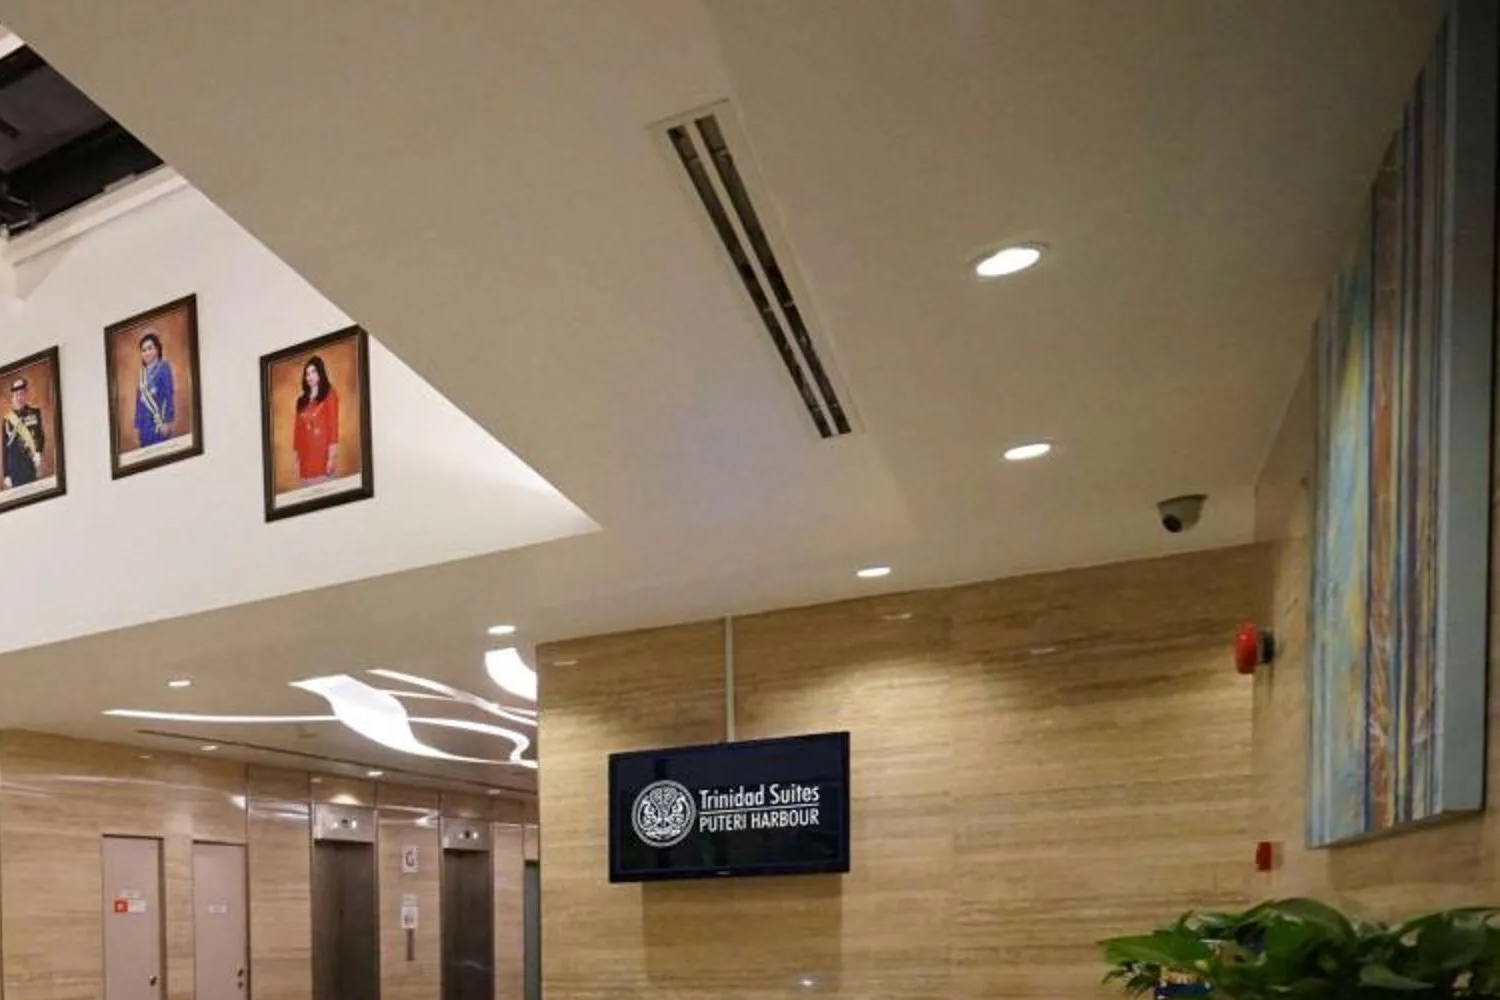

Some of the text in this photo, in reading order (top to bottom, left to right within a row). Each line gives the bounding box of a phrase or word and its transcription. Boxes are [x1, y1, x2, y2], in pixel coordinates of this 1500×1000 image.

[699, 783, 819, 809] Trinidad Suites
[699, 809, 819, 832] PUTERI HARBOUR
